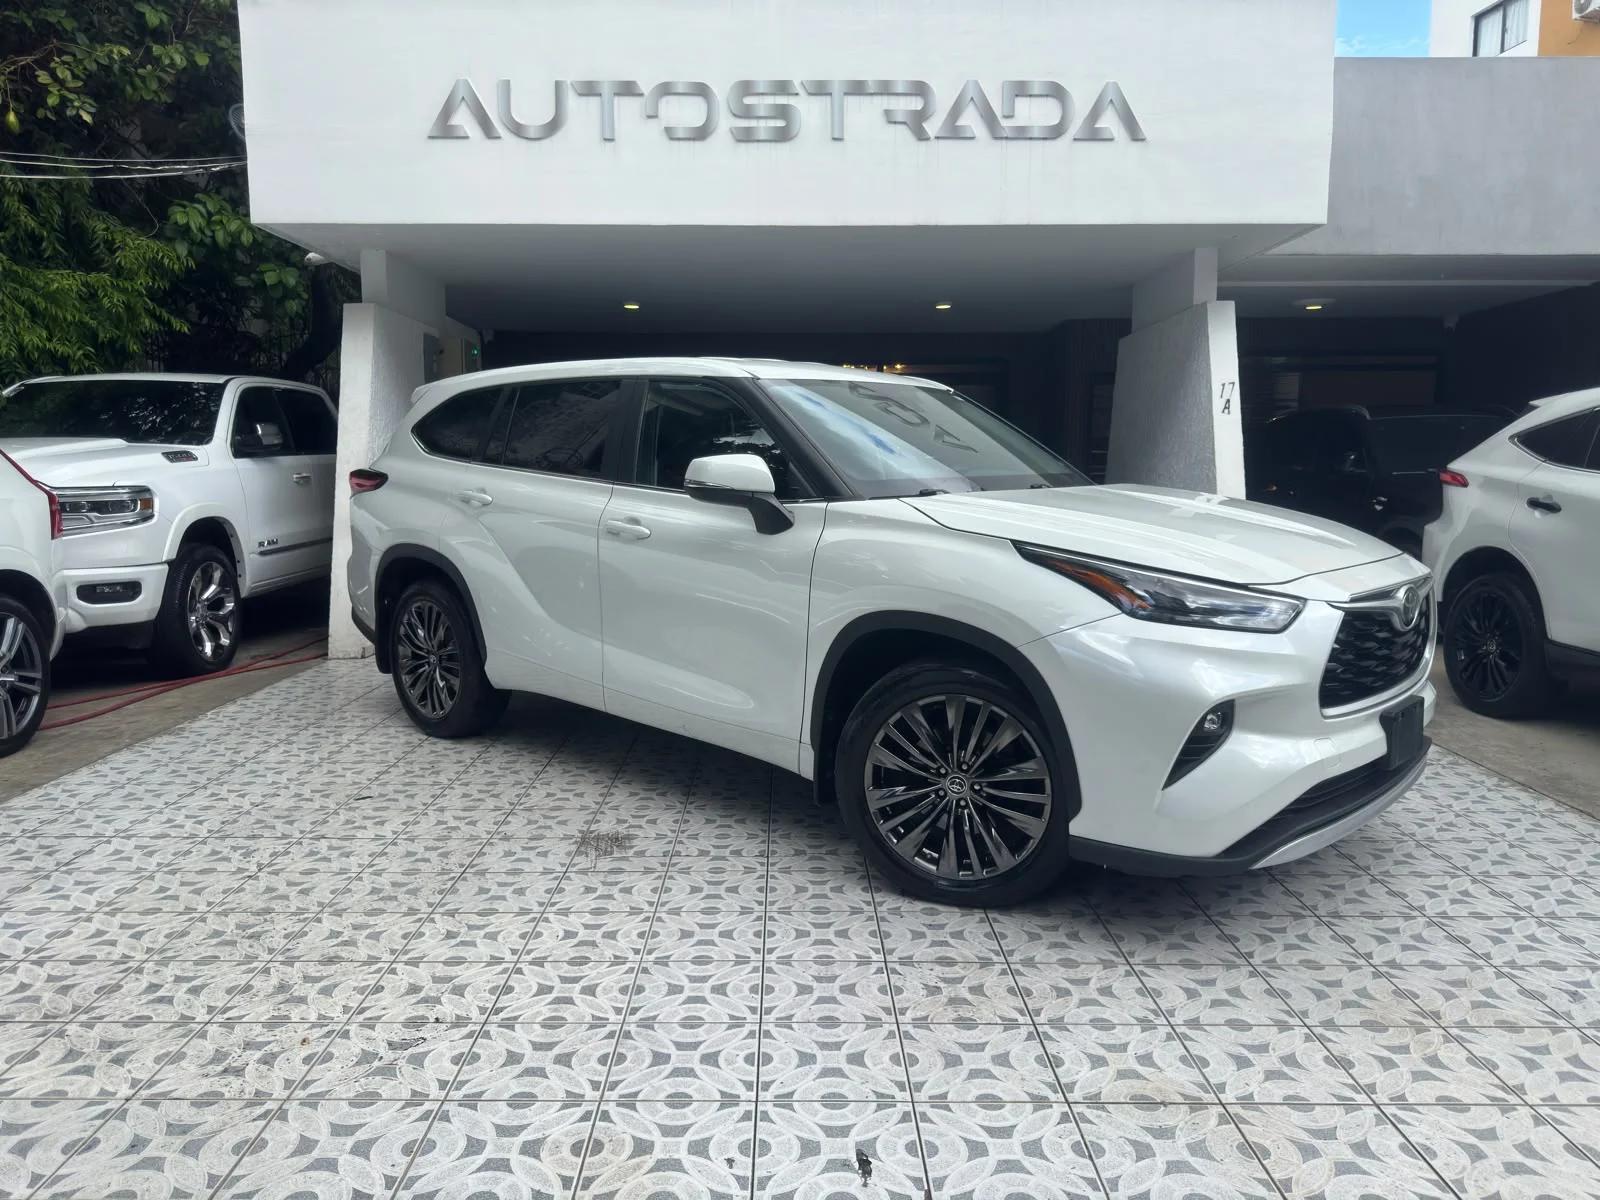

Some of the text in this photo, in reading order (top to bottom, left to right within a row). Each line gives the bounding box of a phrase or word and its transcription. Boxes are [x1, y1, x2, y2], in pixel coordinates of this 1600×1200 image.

[428, 78, 1147, 142] AUTOSTRADA
[1220, 381, 1235, 399] 17
[1221, 398, 1231, 415] A
[258, 538, 279, 548] RAM
